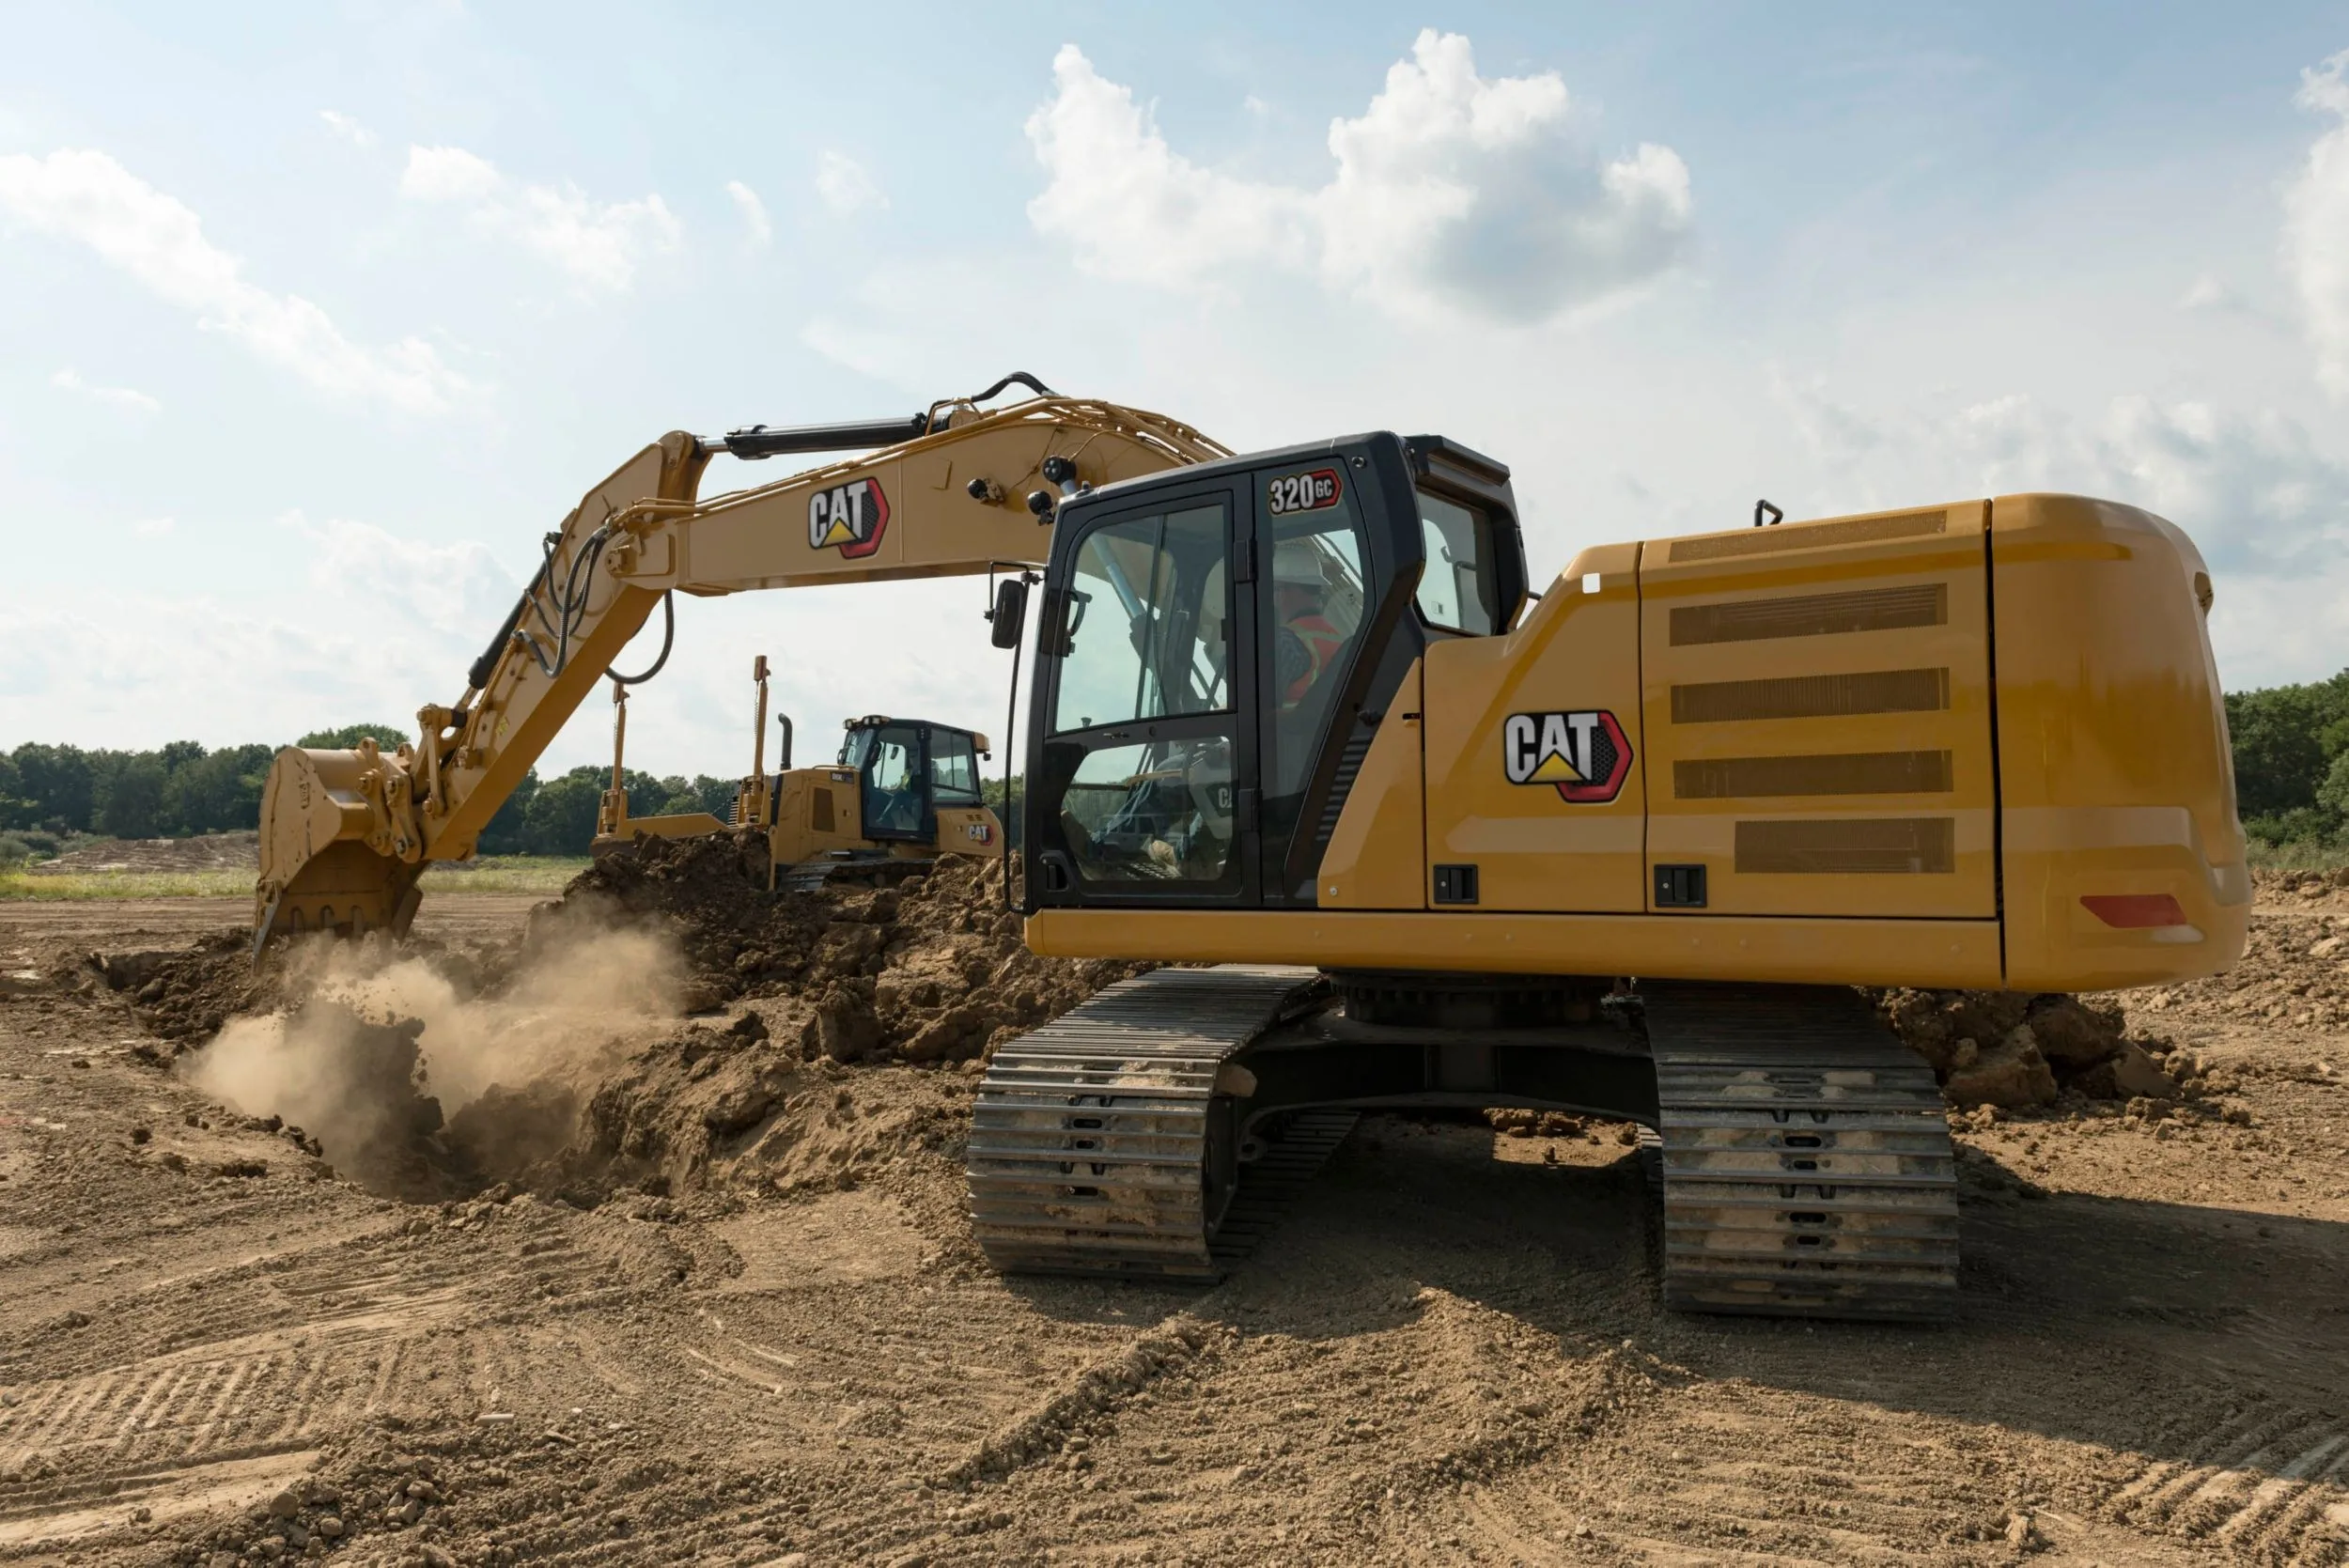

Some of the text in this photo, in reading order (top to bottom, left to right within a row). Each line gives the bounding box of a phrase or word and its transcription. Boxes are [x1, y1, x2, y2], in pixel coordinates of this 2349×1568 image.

[809, 480, 867, 547] CAT
[1270, 474, 1332, 513] 320 GC
[1505, 712, 1598, 782] CAT
[969, 825, 987, 841] CAT
